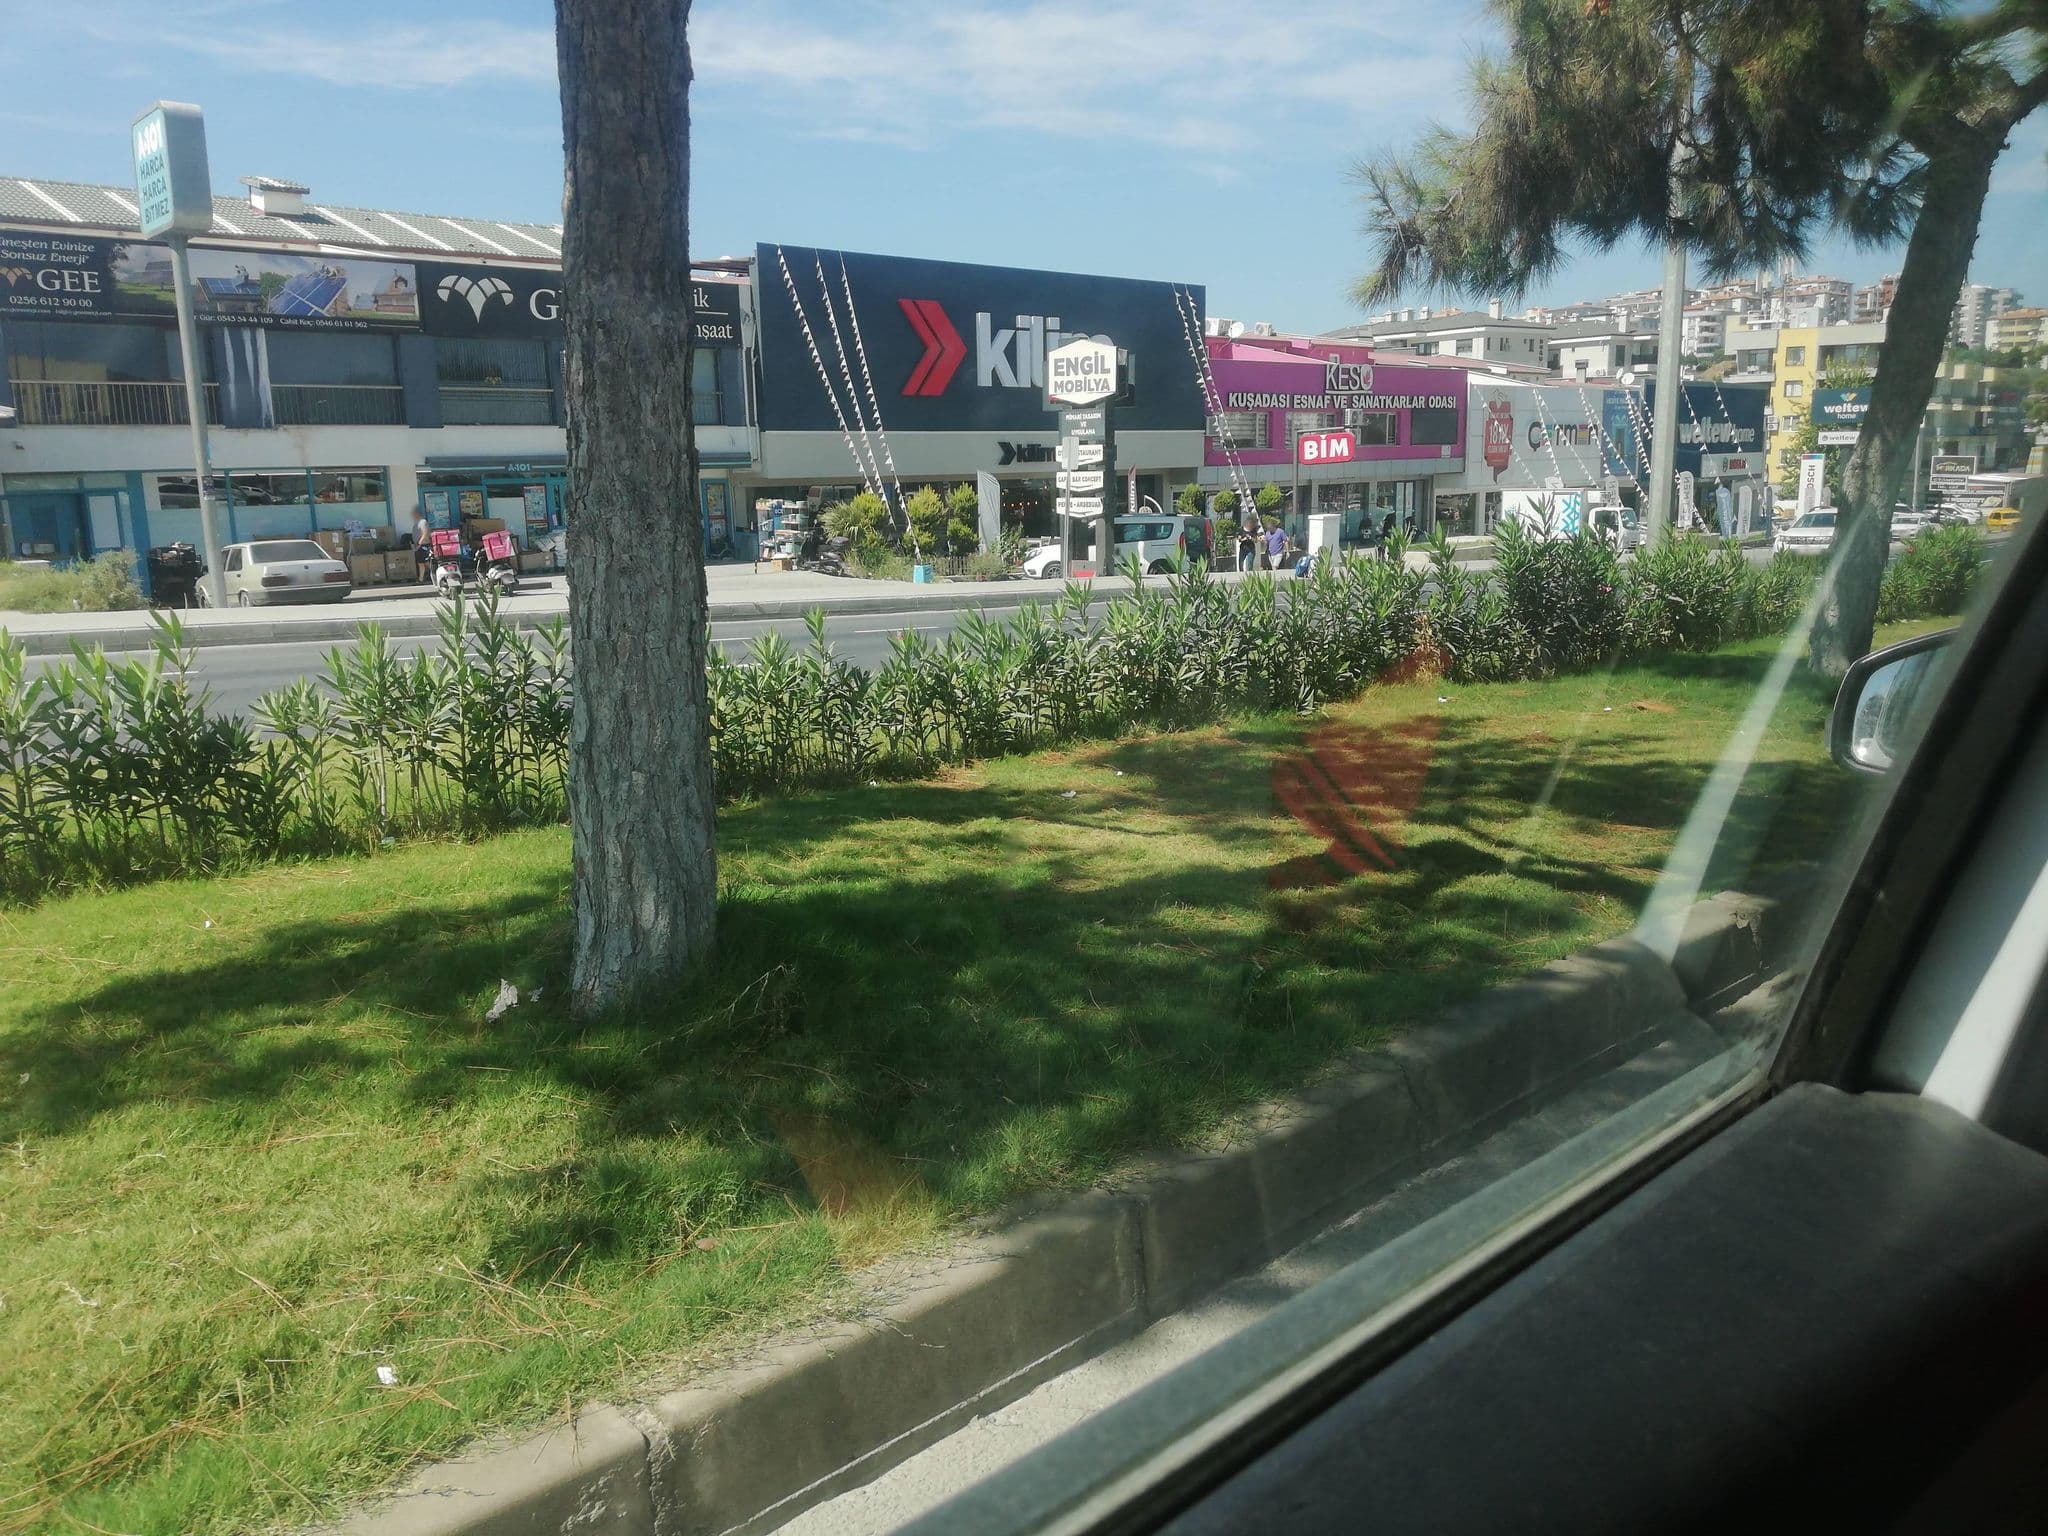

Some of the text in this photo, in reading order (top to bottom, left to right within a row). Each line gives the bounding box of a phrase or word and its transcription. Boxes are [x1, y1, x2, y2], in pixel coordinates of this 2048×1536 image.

[140, 153, 165, 179] HARCA
[142, 176, 167, 203] HARCA
[0, 249, 47, 261] Sonsuz
[36, 268, 102, 293] GEE
[9, 295, 93, 308] 0256 612 90 00
[695, 323, 734, 340] nşaat
[1054, 351, 1111, 376] ENGİL
[1054, 376, 1110, 393] MOBİLYA
[1326, 364, 1374, 391] KESO
[1228, 392, 1456, 411] KUŞADASI ESNAF VE SANATKARLAR ODASI
[1303, 434, 1350, 460] BİM
[1806, 464, 1816, 489] OSCH
